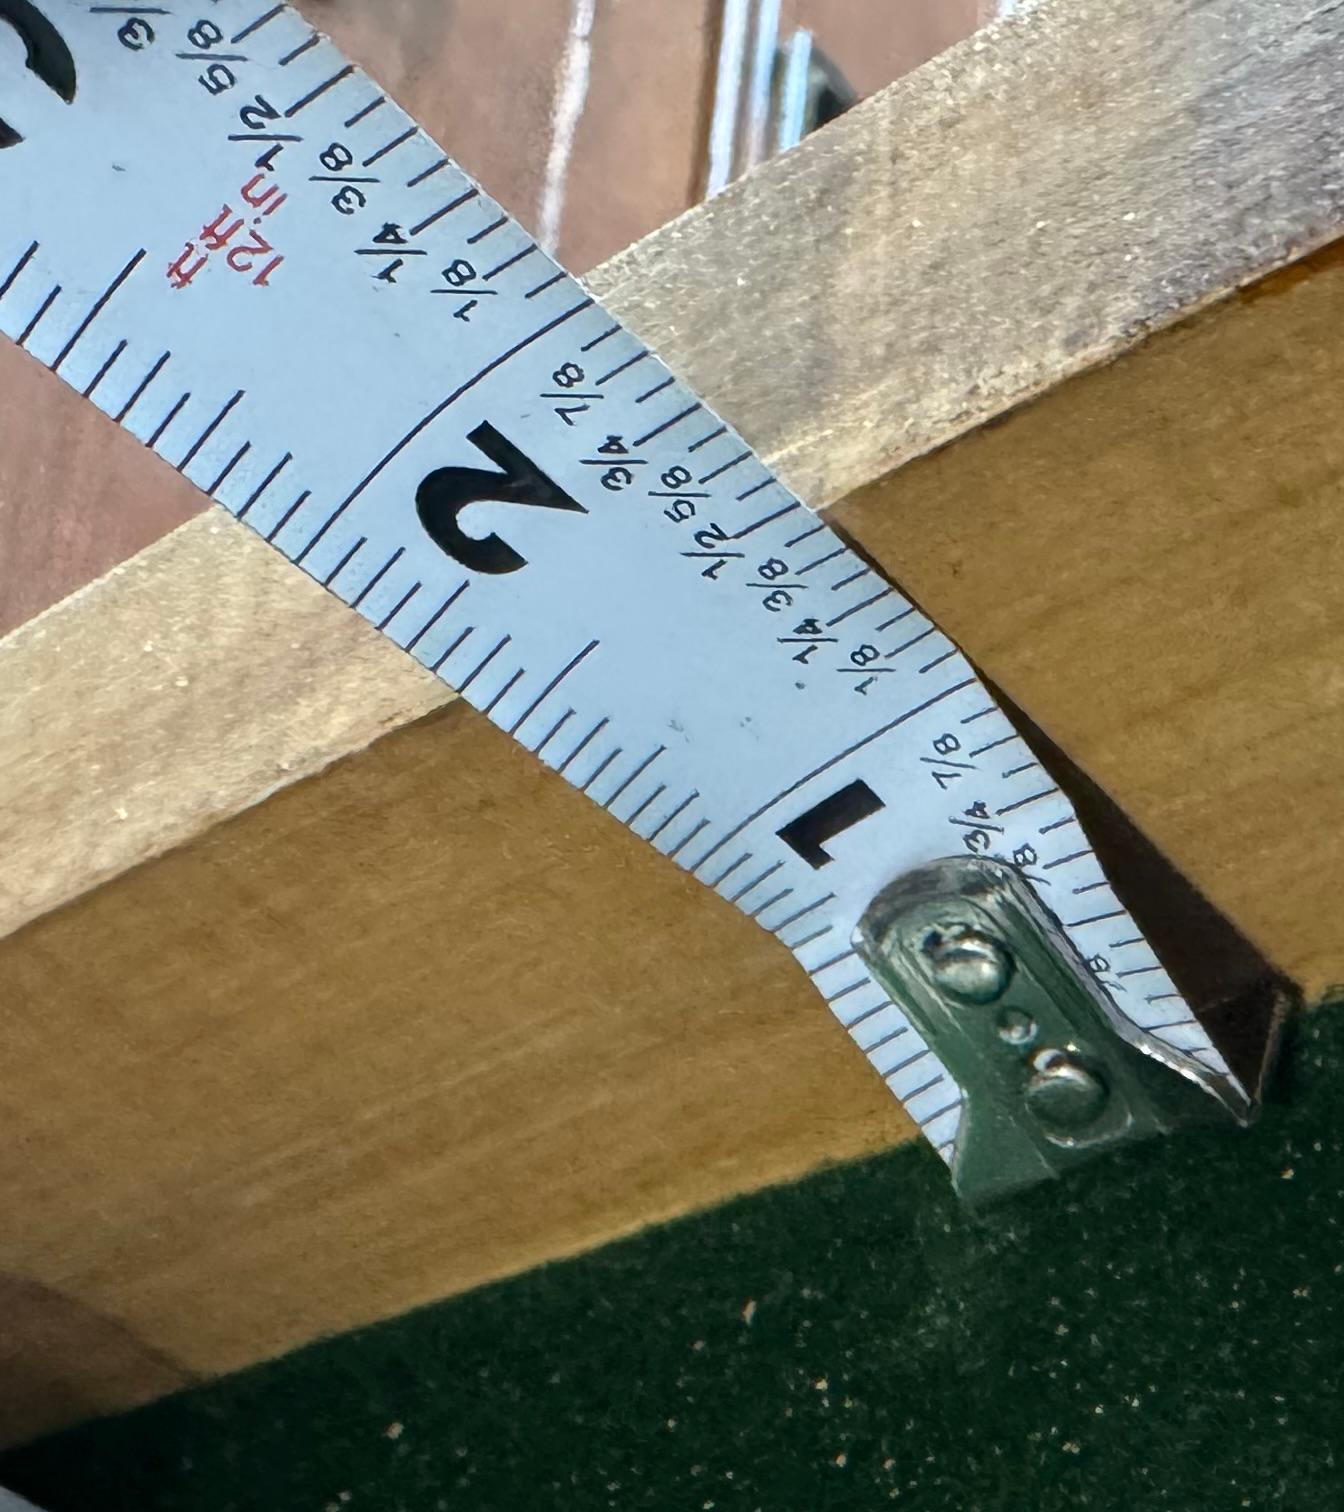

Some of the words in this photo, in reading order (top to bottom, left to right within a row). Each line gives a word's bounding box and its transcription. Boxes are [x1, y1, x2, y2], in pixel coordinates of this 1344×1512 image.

[90, 6, 172, 50] 3/
[175, 19, 248, 95] 5/8
[228, 94, 304, 172] 1/2
[240, 173, 288, 225] in
[308, 142, 381, 215] 3/8
[354, 222, 427, 283] 1/4
[430, 259, 497, 322] 1/8
[540, 362, 604, 426] 7/8
[579, 435, 648, 491] 3/4
[415, 420, 588, 574] 2
[648, 465, 711, 523] 5/8
[680, 523, 745, 580] 1/2
[746, 558, 809, 612] 3/8
[776, 618, 839, 664] 1/4
[836, 644, 896, 695] 1/8
[920, 733, 979, 789] 7/8
[776, 778, 887, 870] 1
[948, 800, 1004, 858] 3/4
